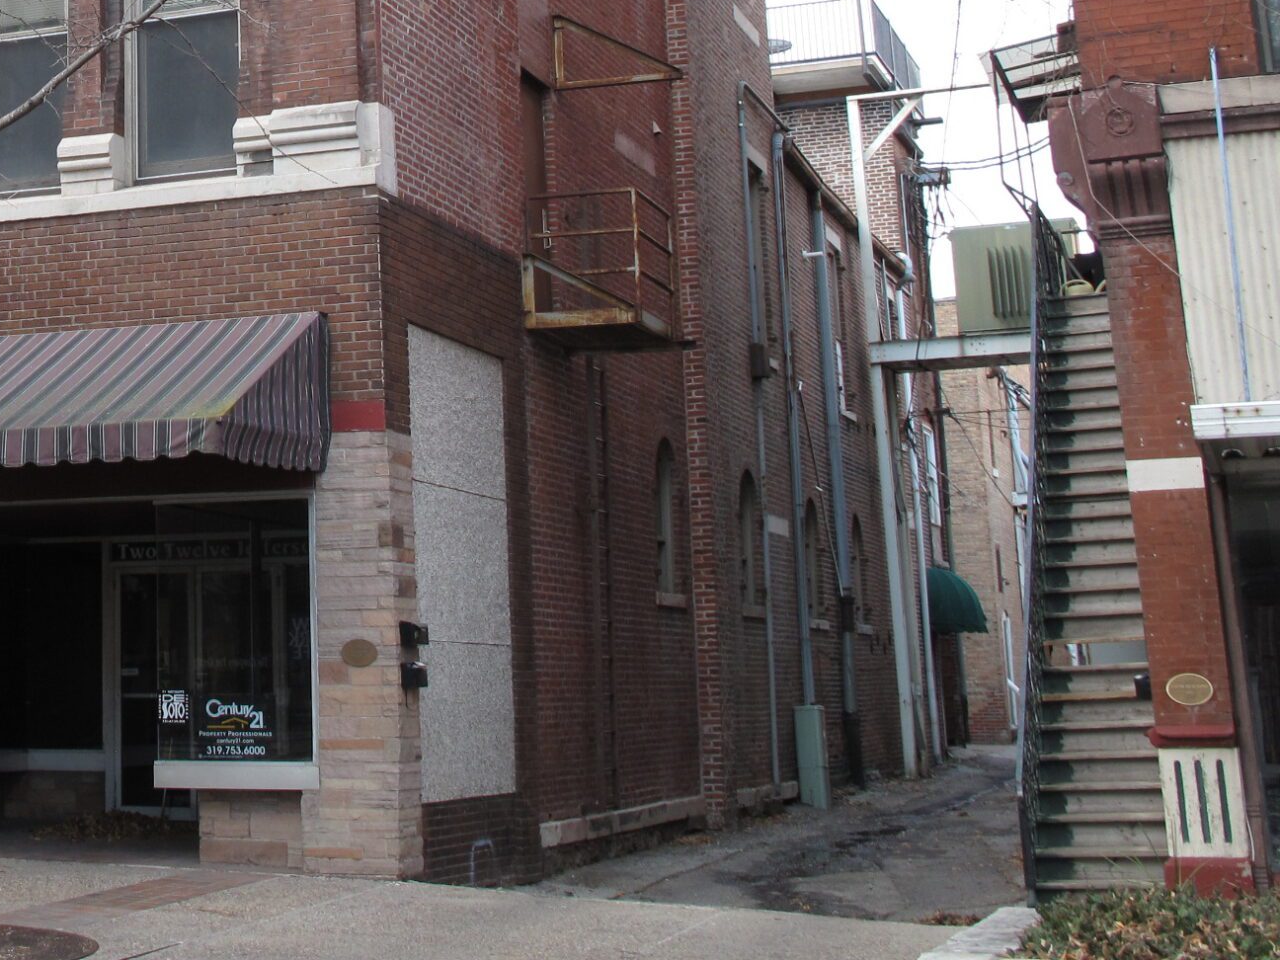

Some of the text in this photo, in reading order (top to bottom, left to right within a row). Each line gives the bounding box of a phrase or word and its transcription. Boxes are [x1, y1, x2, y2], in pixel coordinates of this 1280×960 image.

[118, 543, 157, 559] Two
[163, 539, 230, 559] Twelve
[162, 694, 185, 702] DE
[162, 702, 185, 719] SOTO
[206, 699, 254, 718] Century
[250, 711, 264, 729] 21
[206, 745, 266, 756] 319.753.6000
